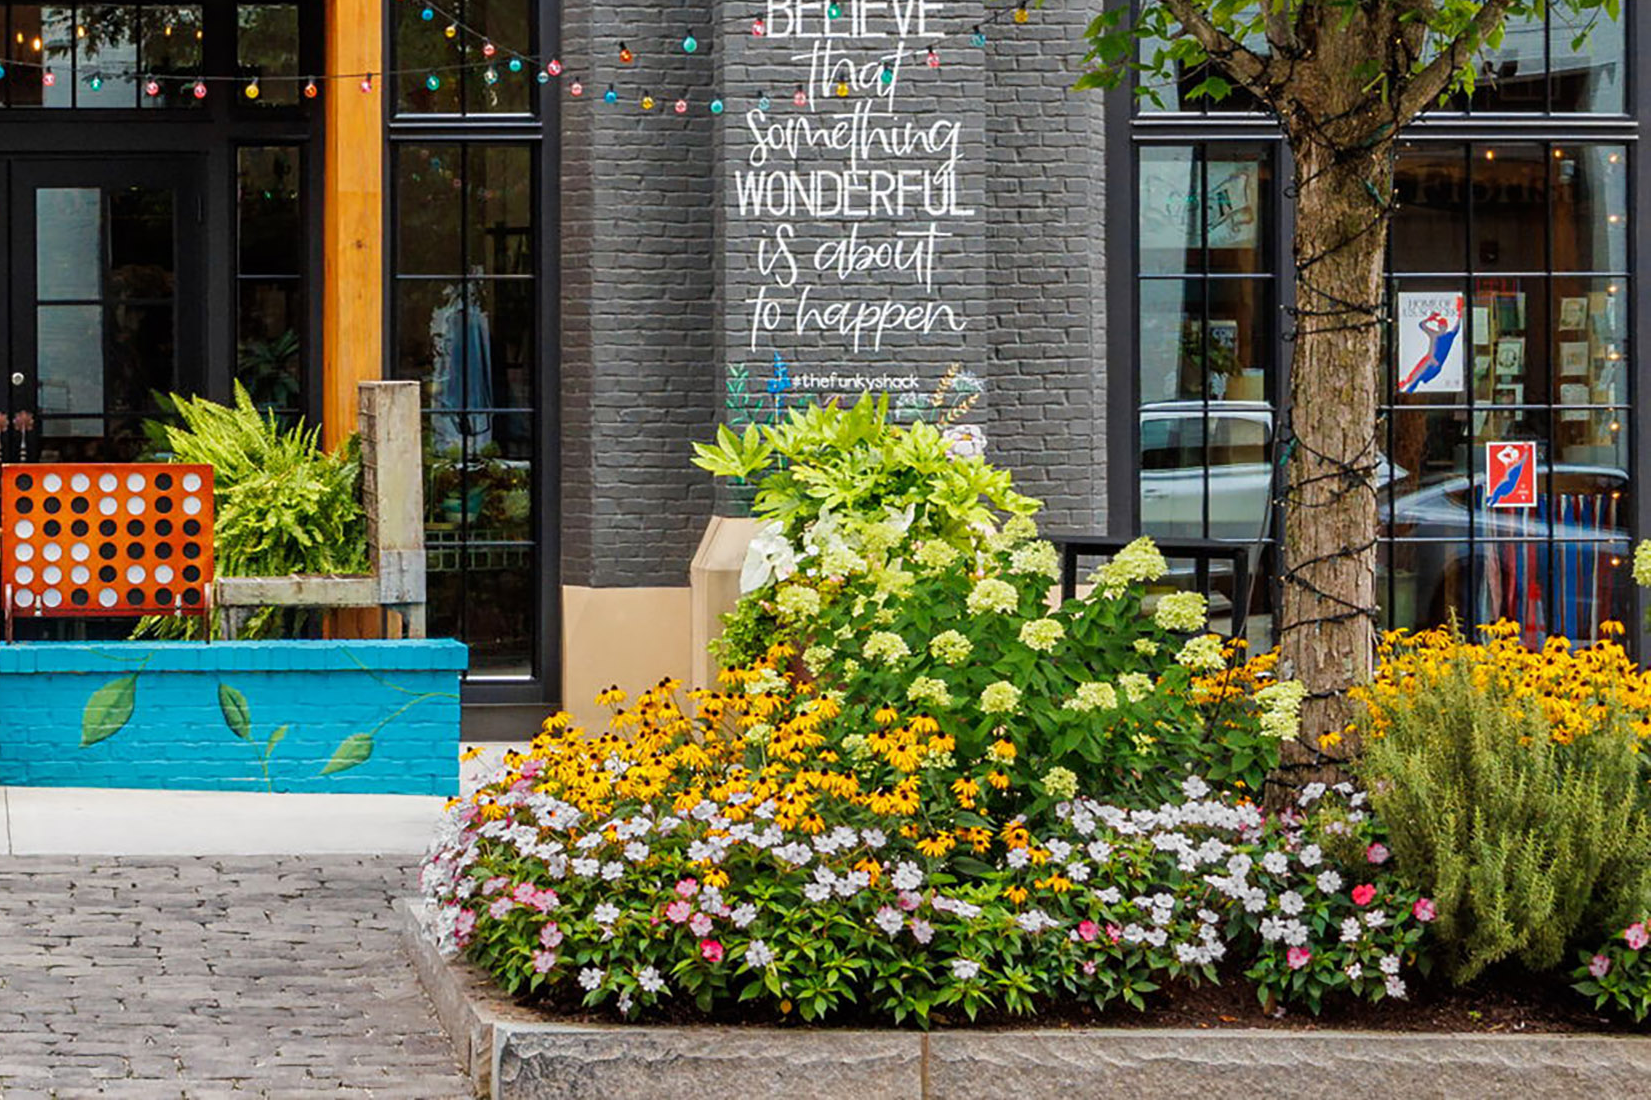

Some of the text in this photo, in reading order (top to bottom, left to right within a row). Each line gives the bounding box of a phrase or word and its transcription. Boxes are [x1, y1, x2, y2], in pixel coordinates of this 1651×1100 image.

[791, 39, 933, 112] that
[746, 99, 965, 186] something
[735, 169, 975, 217] WONDERFUL
[758, 222, 953, 294] is about
[745, 285, 967, 354] to happen
[792, 371, 920, 390] #thefunkyshack
